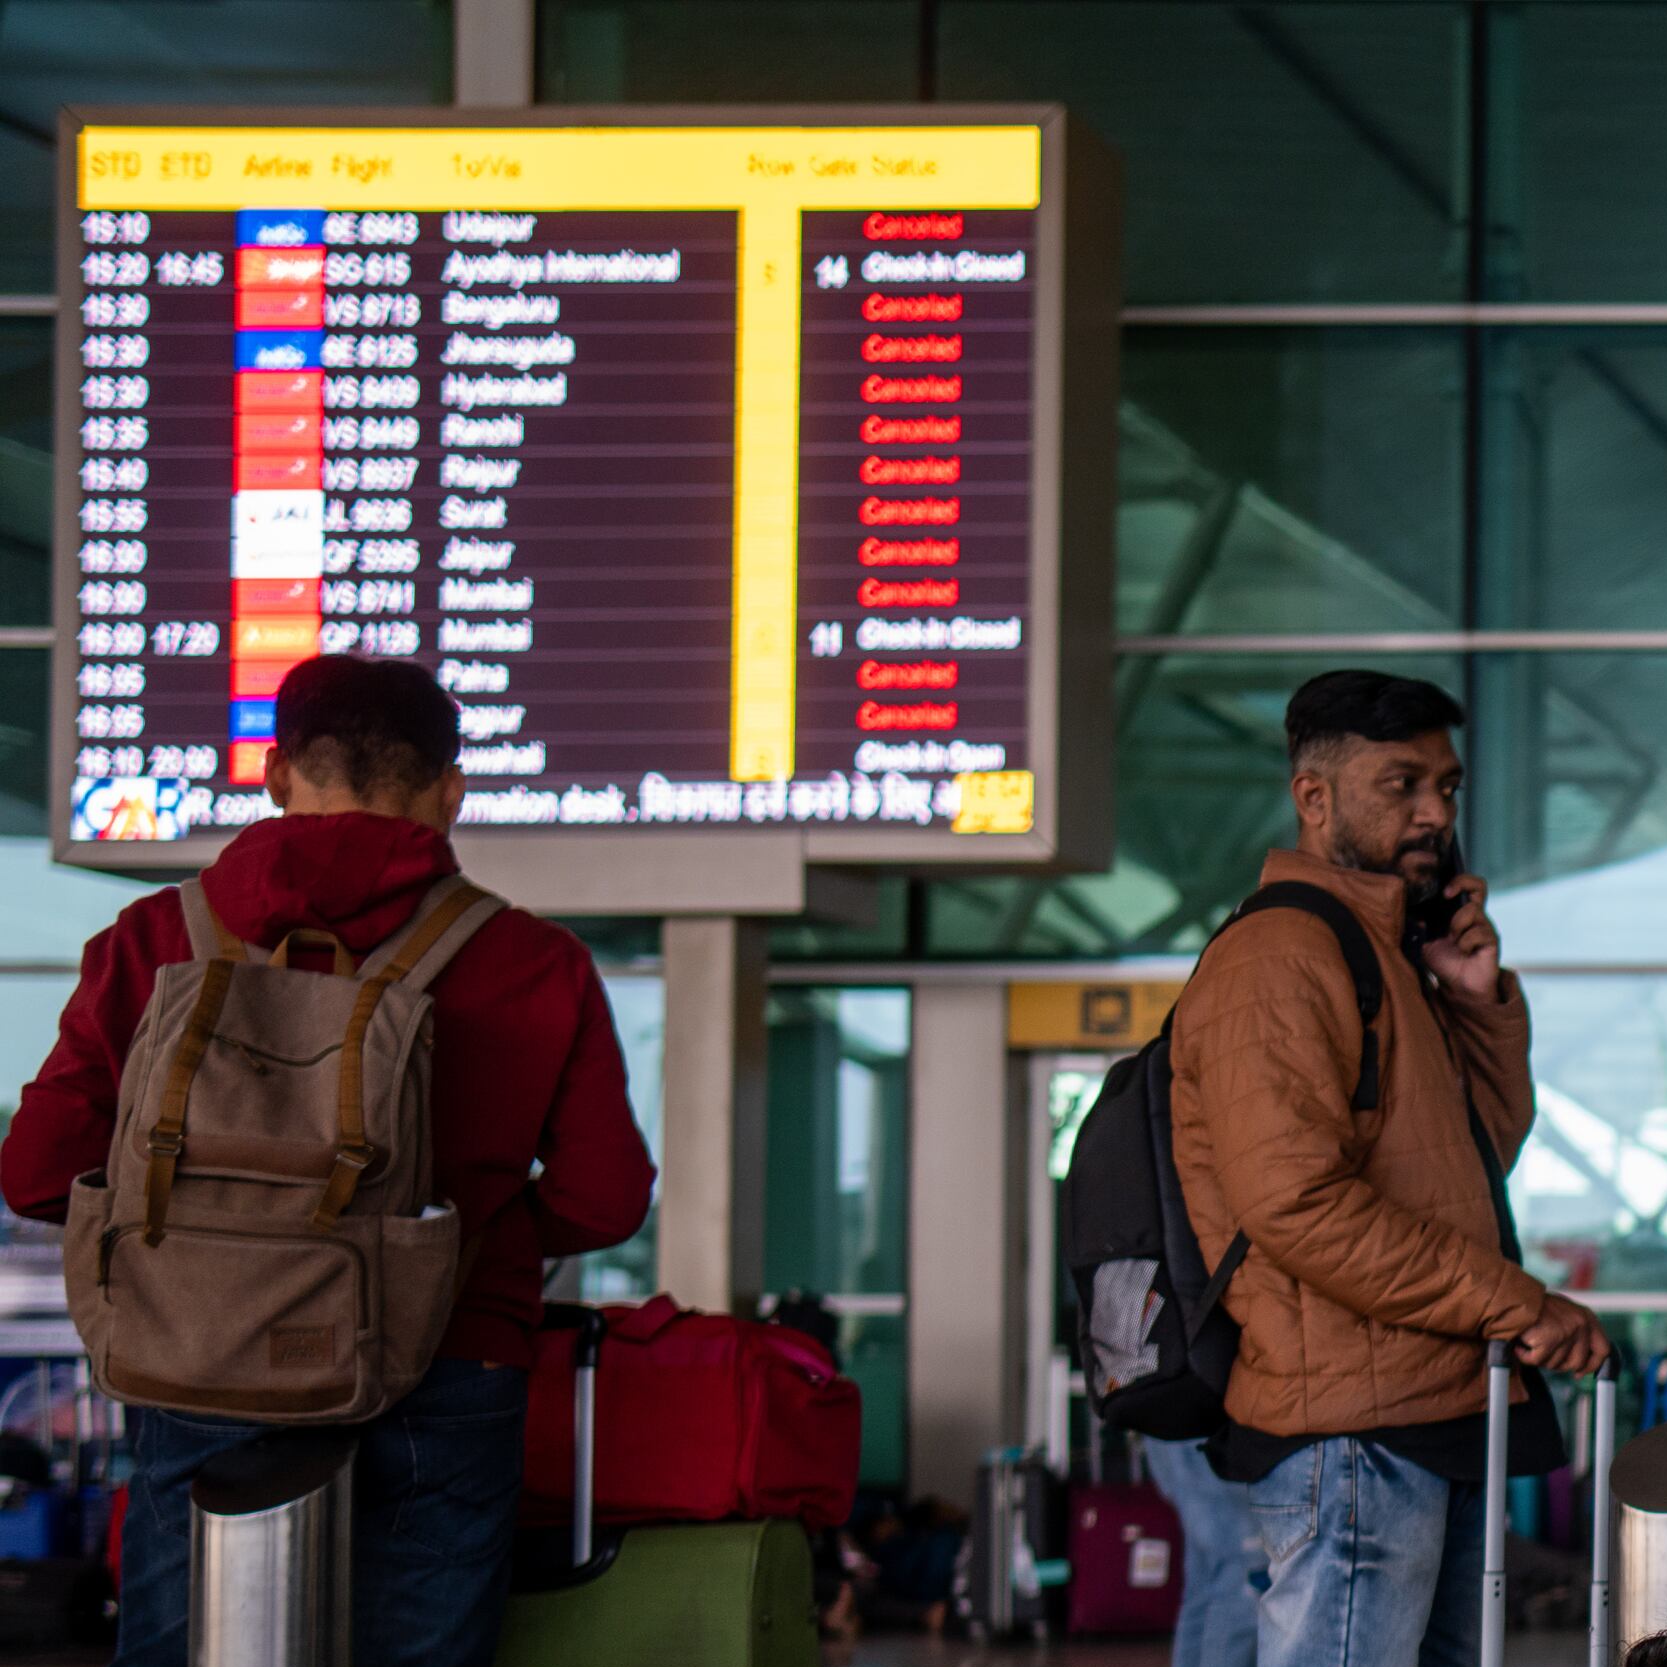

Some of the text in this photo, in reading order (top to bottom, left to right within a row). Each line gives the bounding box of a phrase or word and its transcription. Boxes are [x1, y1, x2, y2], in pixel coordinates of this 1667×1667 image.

[91, 151, 142, 179] STD
[160, 152, 212, 179] ETD
[81, 212, 150, 244] 15:10
[80, 252, 150, 285] 15:20
[80, 294, 150, 326] 15:30
[80, 335, 149, 367] 15:30
[80, 376, 149, 408] 15:30
[80, 416, 149, 450] 15:35
[456, 741, 546, 775] umbai
